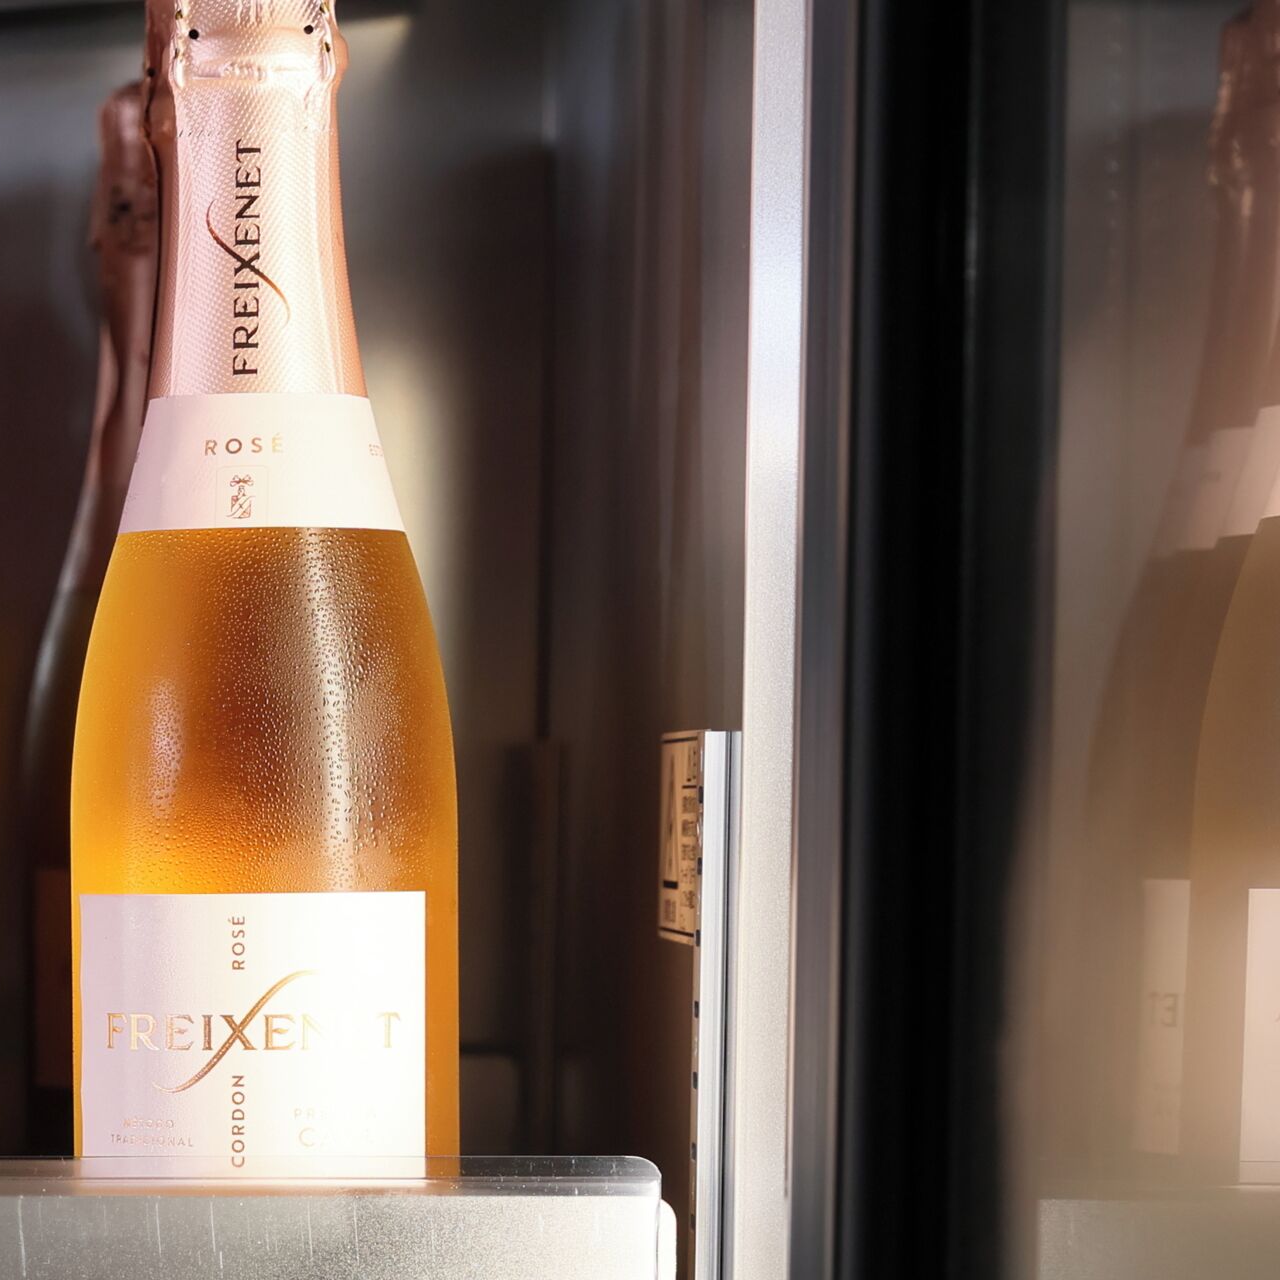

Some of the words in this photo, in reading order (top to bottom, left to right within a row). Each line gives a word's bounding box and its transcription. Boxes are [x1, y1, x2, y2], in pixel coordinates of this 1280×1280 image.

[206, 139, 291, 376] FREIXENET
[204, 433, 285, 456] ROSÉ
[228, 915, 246, 971] ROSÉ
[230, 1074, 246, 1168] CORDON
